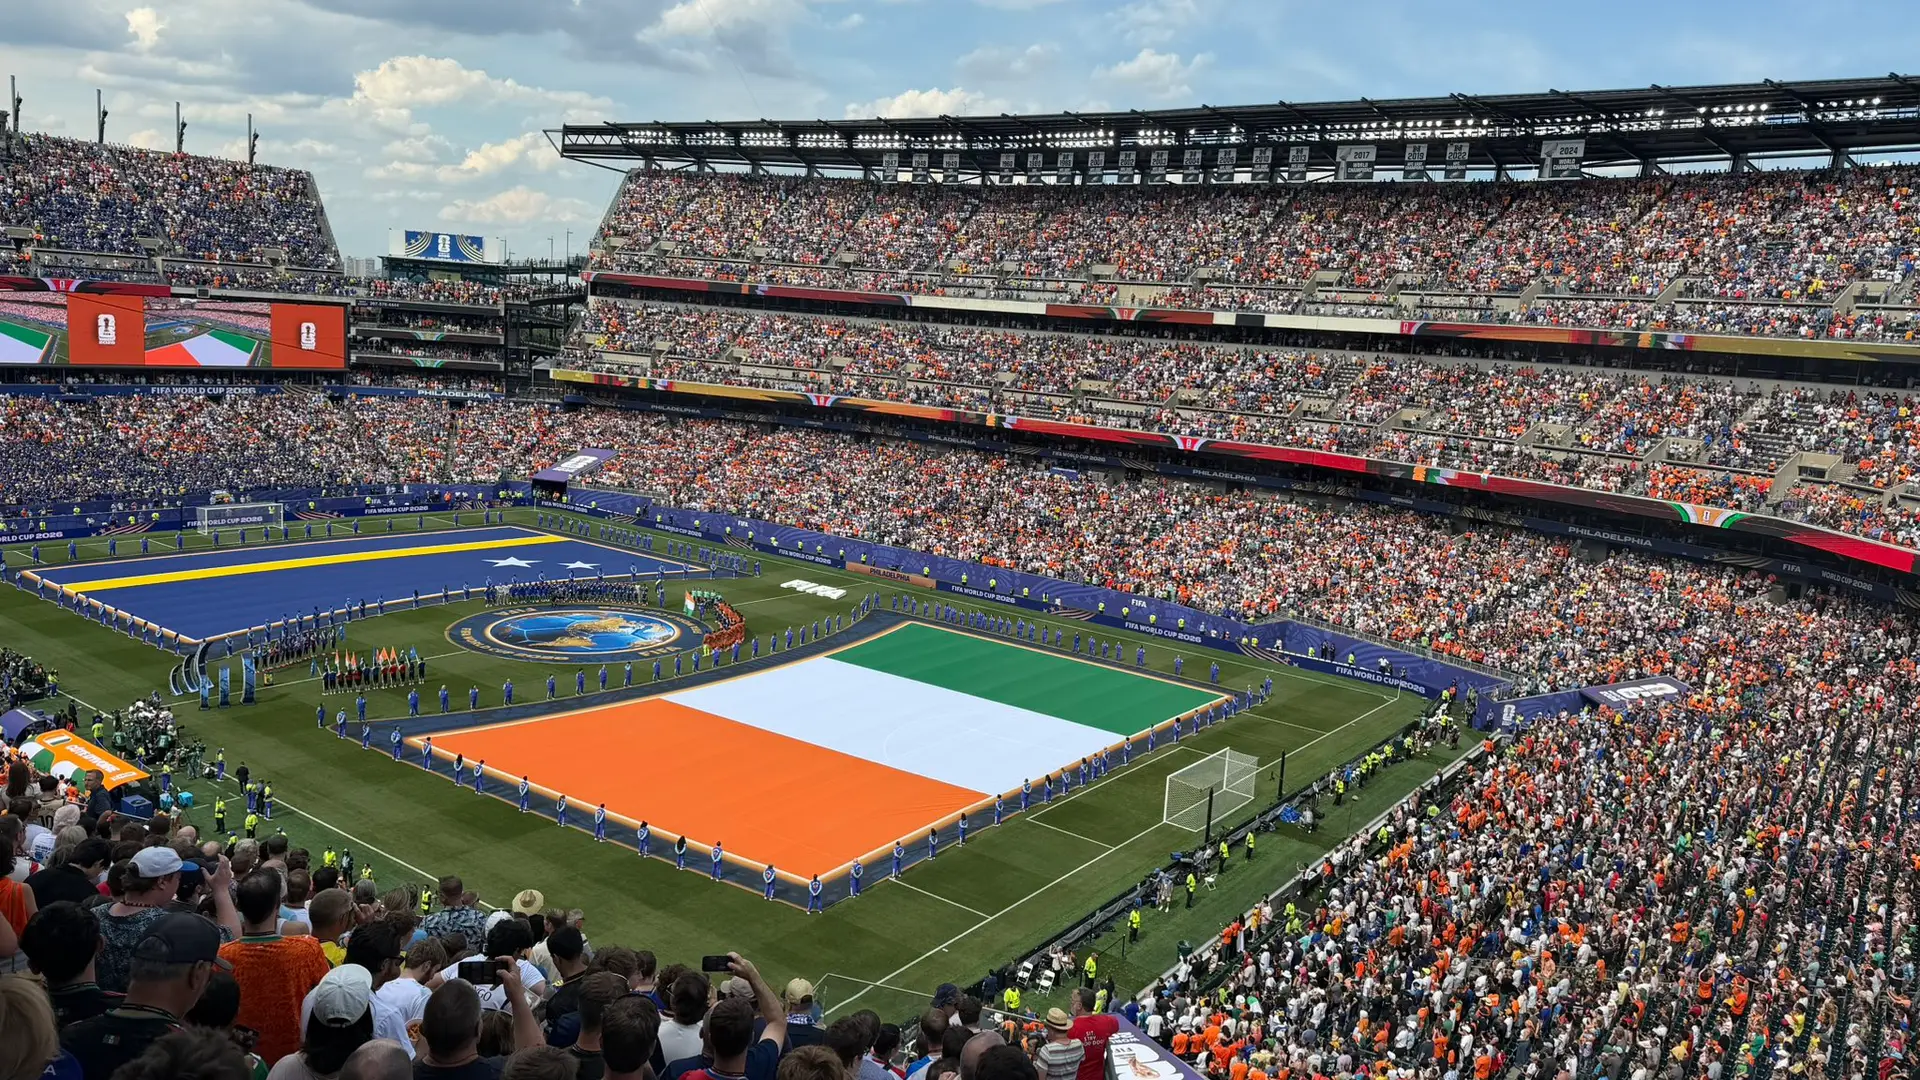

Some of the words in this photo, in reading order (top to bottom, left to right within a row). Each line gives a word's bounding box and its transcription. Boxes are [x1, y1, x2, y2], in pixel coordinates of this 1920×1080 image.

[1448, 152, 1467, 160] 2022
[1560, 147, 1578, 155] 2024
[417, 390, 491, 399] PHILADELPHIA
[651, 404, 700, 414] PHILADELPHIA
[928, 434, 976, 445] PHILADELPHIA
[1192, 469, 1257, 482] PHILADELPHIA
[36, 531, 63, 539] 2026
[1568, 527, 1652, 547] PHILADELPHIA
[870, 568, 910, 582] PHILADELPHIA
[1782, 564, 1801, 573] FIFA
[1821, 571, 1840, 581] WORLD
[1842, 576, 1852, 584] CUP
[1852, 580, 1873, 591] 2026
[951, 585, 963, 593] FIFA
[964, 588, 983, 597] WORLD
[996, 594, 1016, 603] 2026
[1131, 599, 1147, 607] FIFA
[1125, 622, 1139, 630] FIFA
[1140, 624, 1163, 635] WORLD
[1164, 630, 1177, 638] CUP
[1177, 633, 1202, 643] 2026
[1336, 667, 1352, 675] FIFA
[1354, 670, 1382, 682] WORLD
[1383, 677, 1400, 685] CUP
[1399, 680, 1425, 694] 2026
